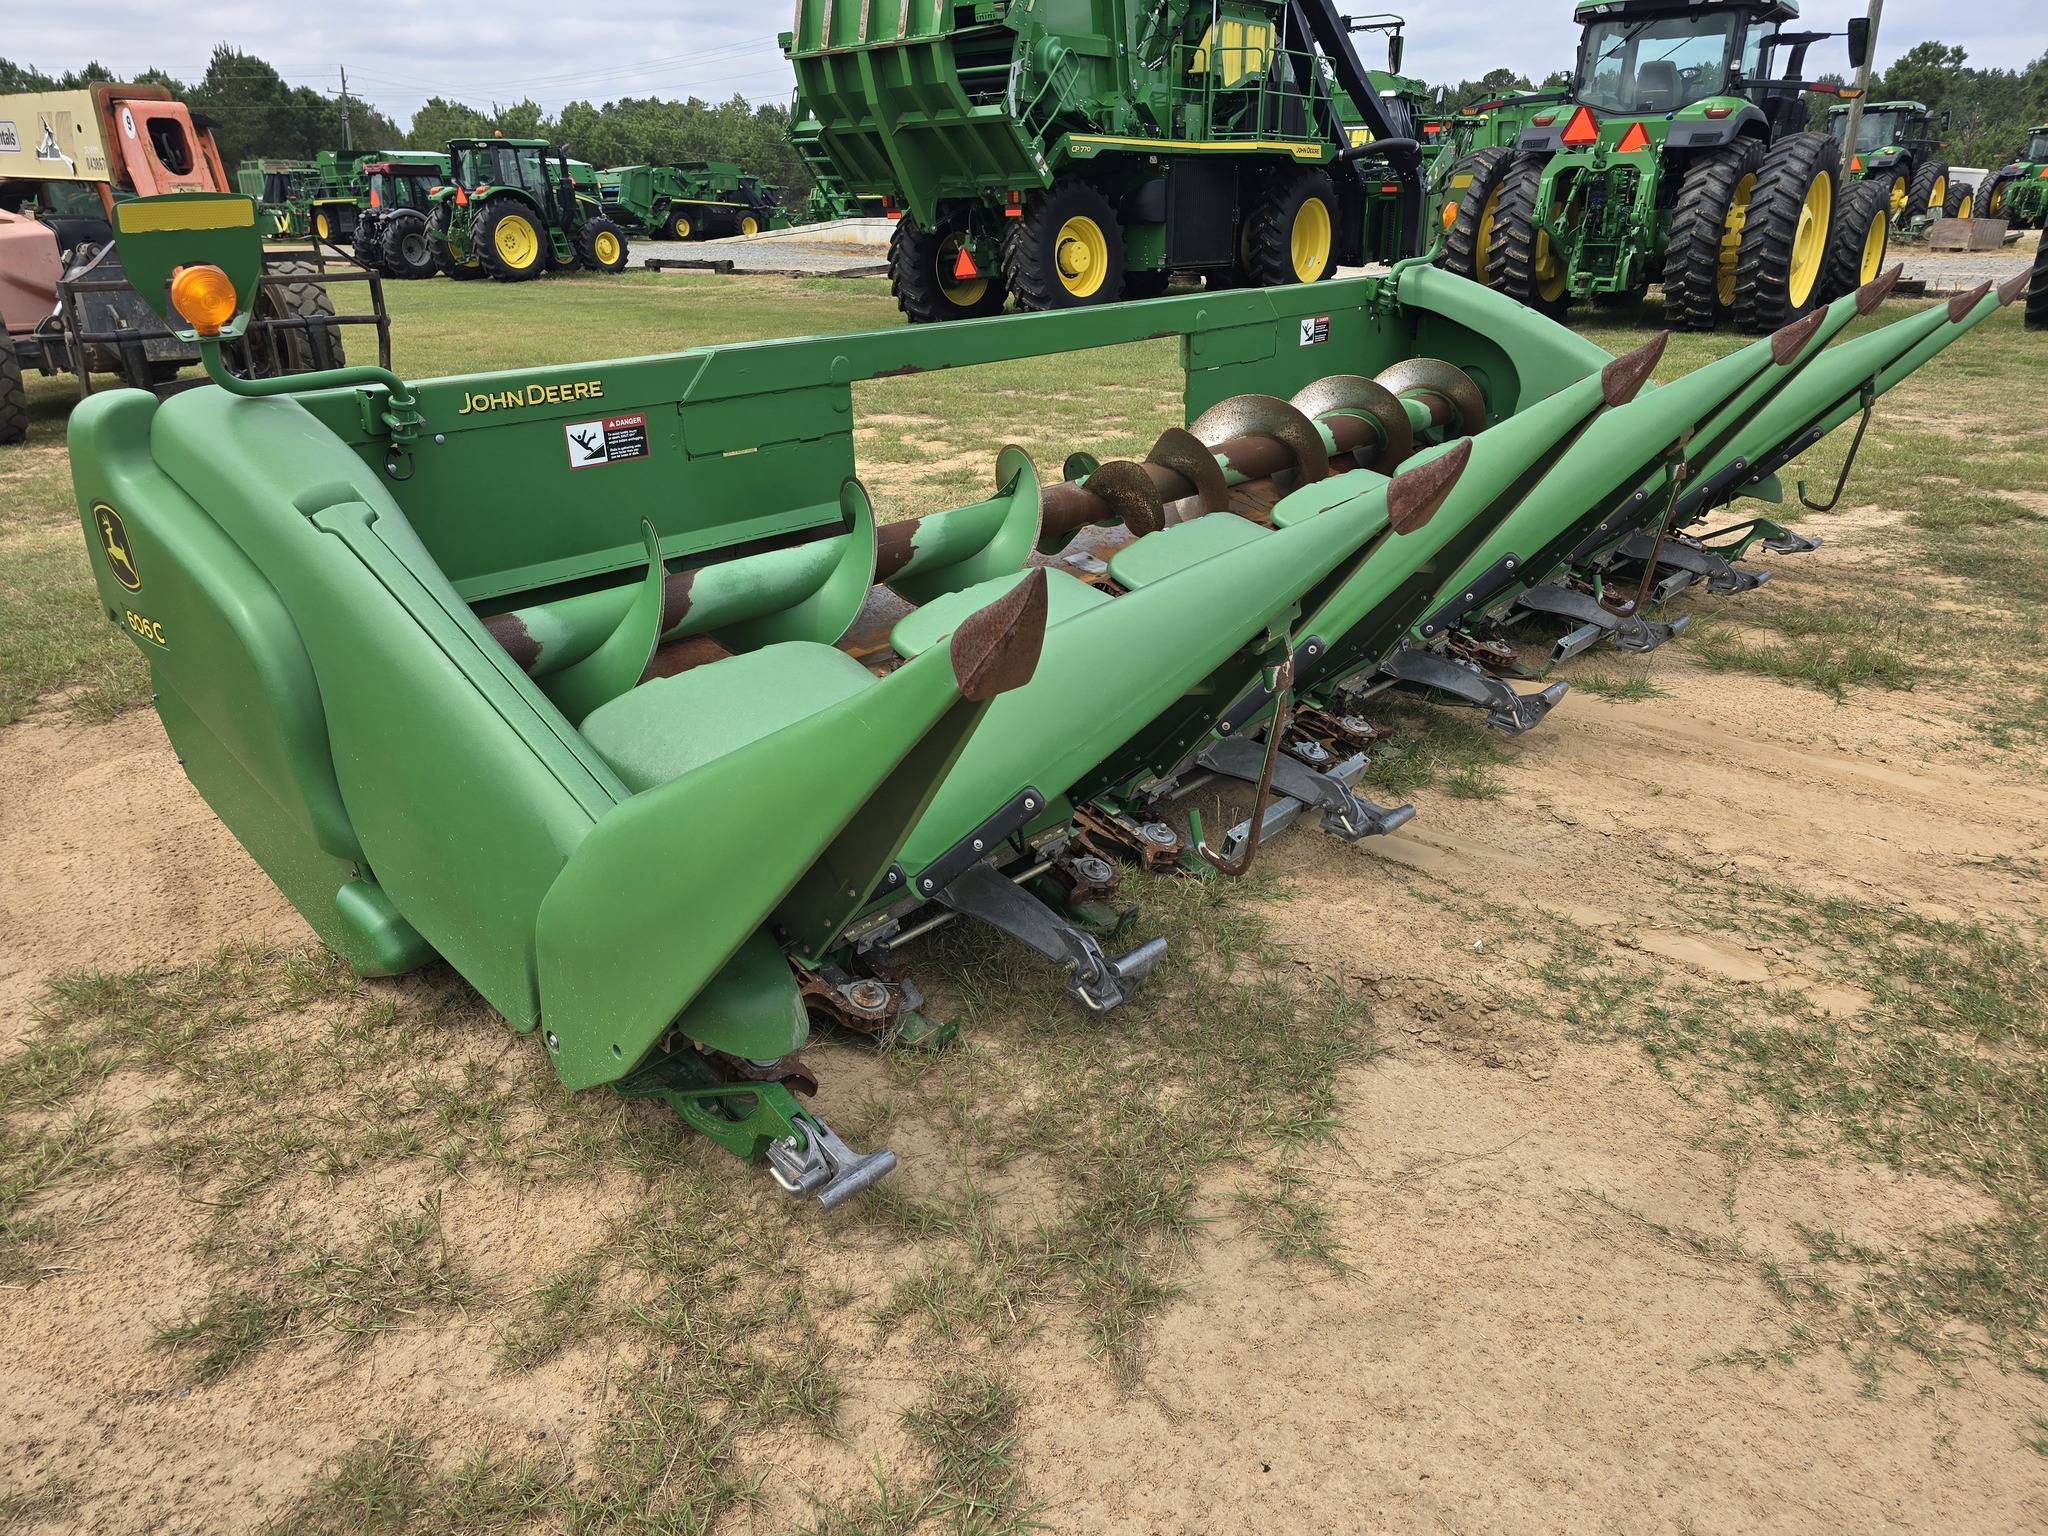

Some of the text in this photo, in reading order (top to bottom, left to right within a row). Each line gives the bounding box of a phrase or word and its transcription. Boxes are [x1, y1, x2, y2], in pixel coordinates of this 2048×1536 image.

[126, 115, 132, 131] 9
[458, 380, 604, 415] JOHN DEERE
[615, 416, 642, 427] DANGER
[126, 610, 166, 644] 606C
